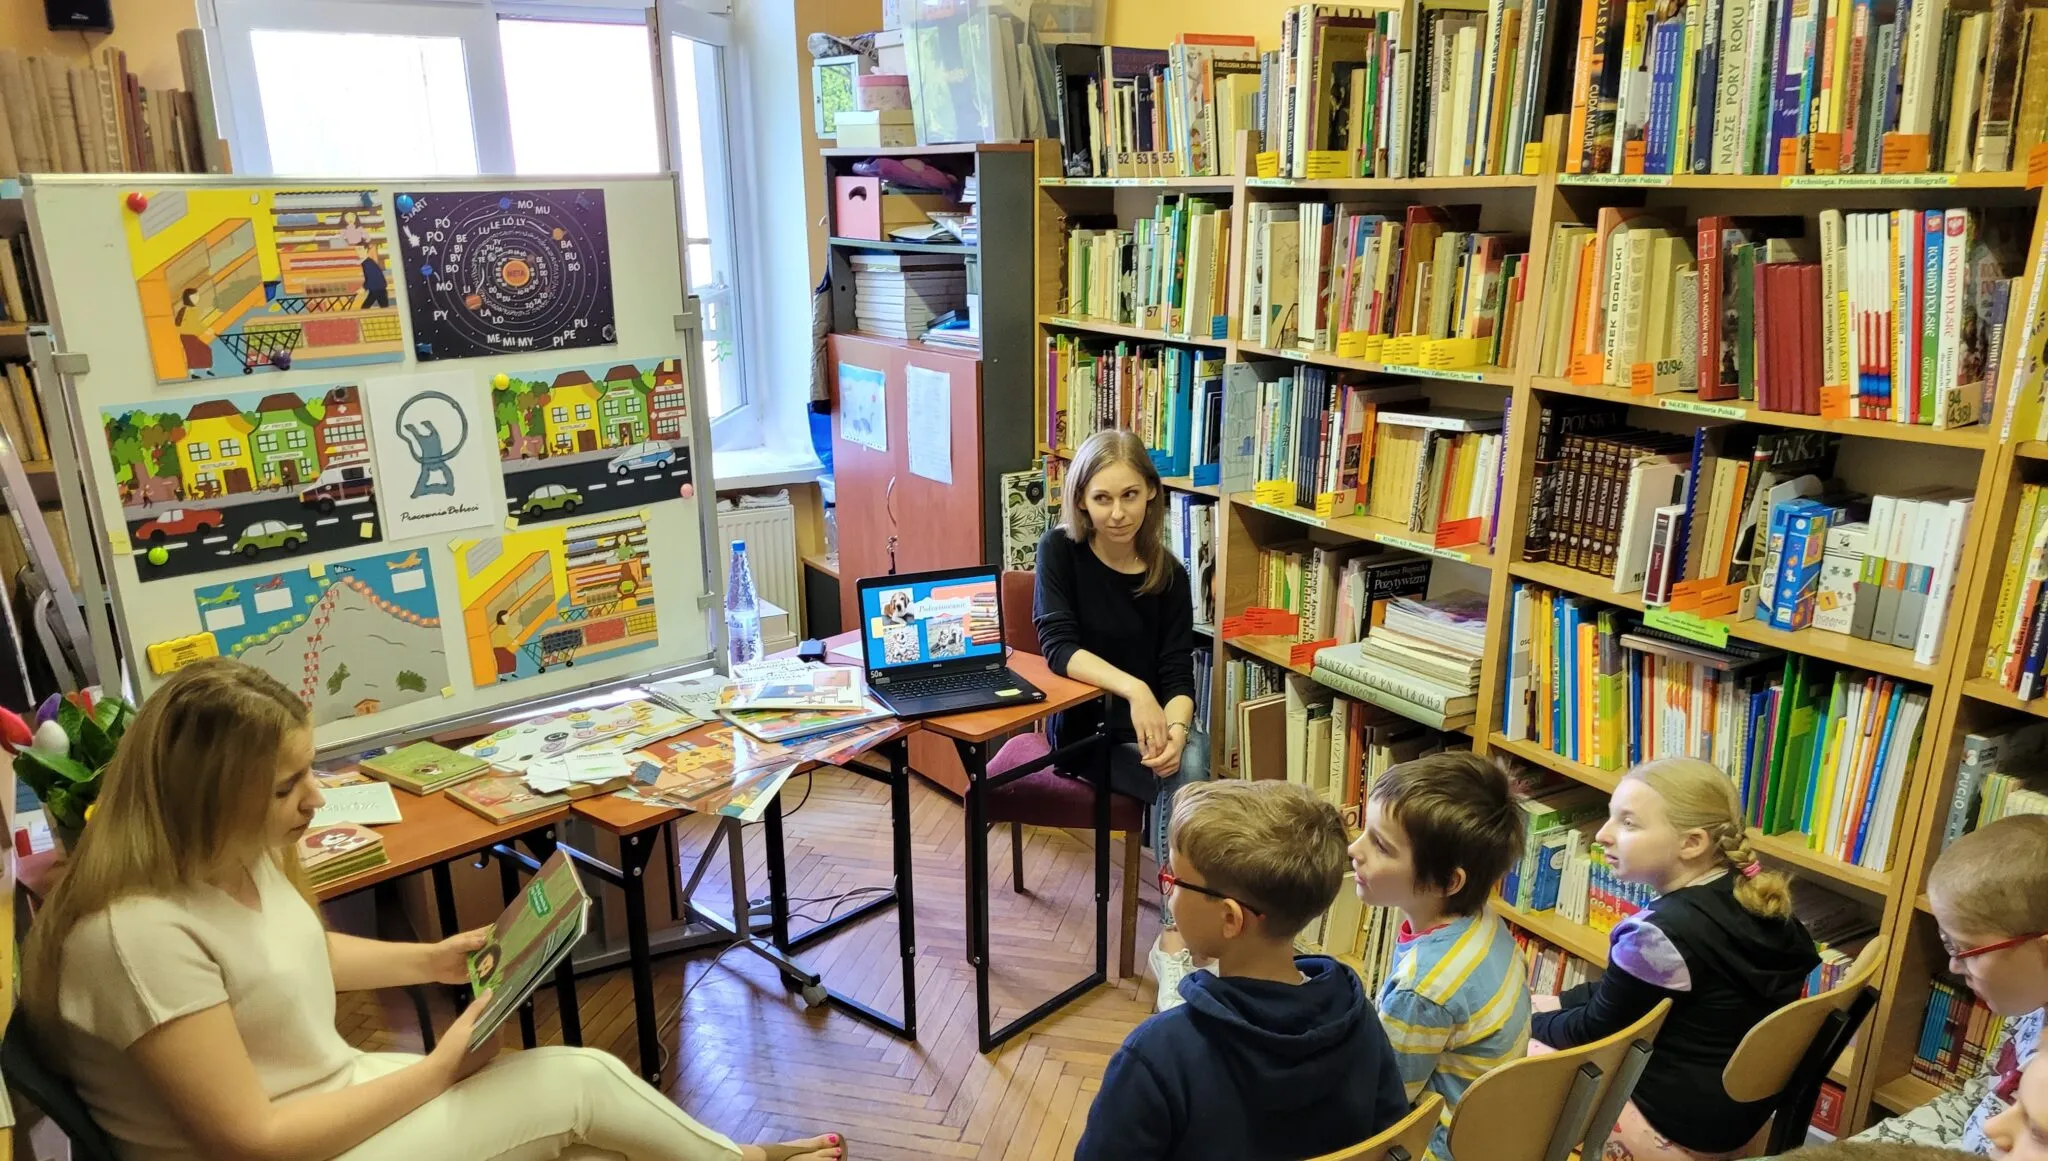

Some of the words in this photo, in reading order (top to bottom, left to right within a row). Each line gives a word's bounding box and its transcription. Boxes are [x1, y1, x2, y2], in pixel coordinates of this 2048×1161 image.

[1593, 0, 1608, 46] OLSKA
[1731, 6, 1745, 53] ROKU
[1726, 64, 1741, 106] PORY
[1587, 84, 1599, 112] CUDA
[1583, 113, 1597, 154] NATURY
[1720, 115, 1737, 165] NASZE
[1117, 153, 1129, 164] 52
[1136, 153, 1148, 164] 53
[1162, 152, 1175, 164] 55
[517, 200, 534, 208] MO
[535, 206, 550, 214] MU
[490, 221, 500, 230] LE
[456, 234, 468, 243] BE
[454, 244, 463, 253] BI
[560, 240, 573, 249] BA
[422, 245, 438, 256] PA
[565, 252, 577, 260] BU
[450, 254, 462, 263] BY
[445, 264, 459, 273] BO
[480, 309, 492, 317] LA
[1146, 305, 1158, 318] 57
[1606, 320, 1617, 370] MAREK
[1612, 247, 1623, 312] BORUCKI
[433, 310, 448, 321] PY
[492, 316, 504, 324] LO
[573, 318, 588, 328] PU
[487, 333, 501, 343] ME
[563, 330, 577, 340] PE
[502, 336, 516, 347] MI
[517, 336, 534, 347] MY
[552, 336, 564, 347] PI
[1988, 323, 2003, 368] HISTORIA
[1334, 493, 1345, 504] 79
[400, 508, 447, 523] Pracownia
[1374, 574, 1426, 591] Pozytywizm
[1380, 678, 1392, 691] NA
[1397, 684, 1442, 710] CHOPIN
[1230, 752, 1239, 769] E
[1954, 771, 1971, 810] PUCIO
